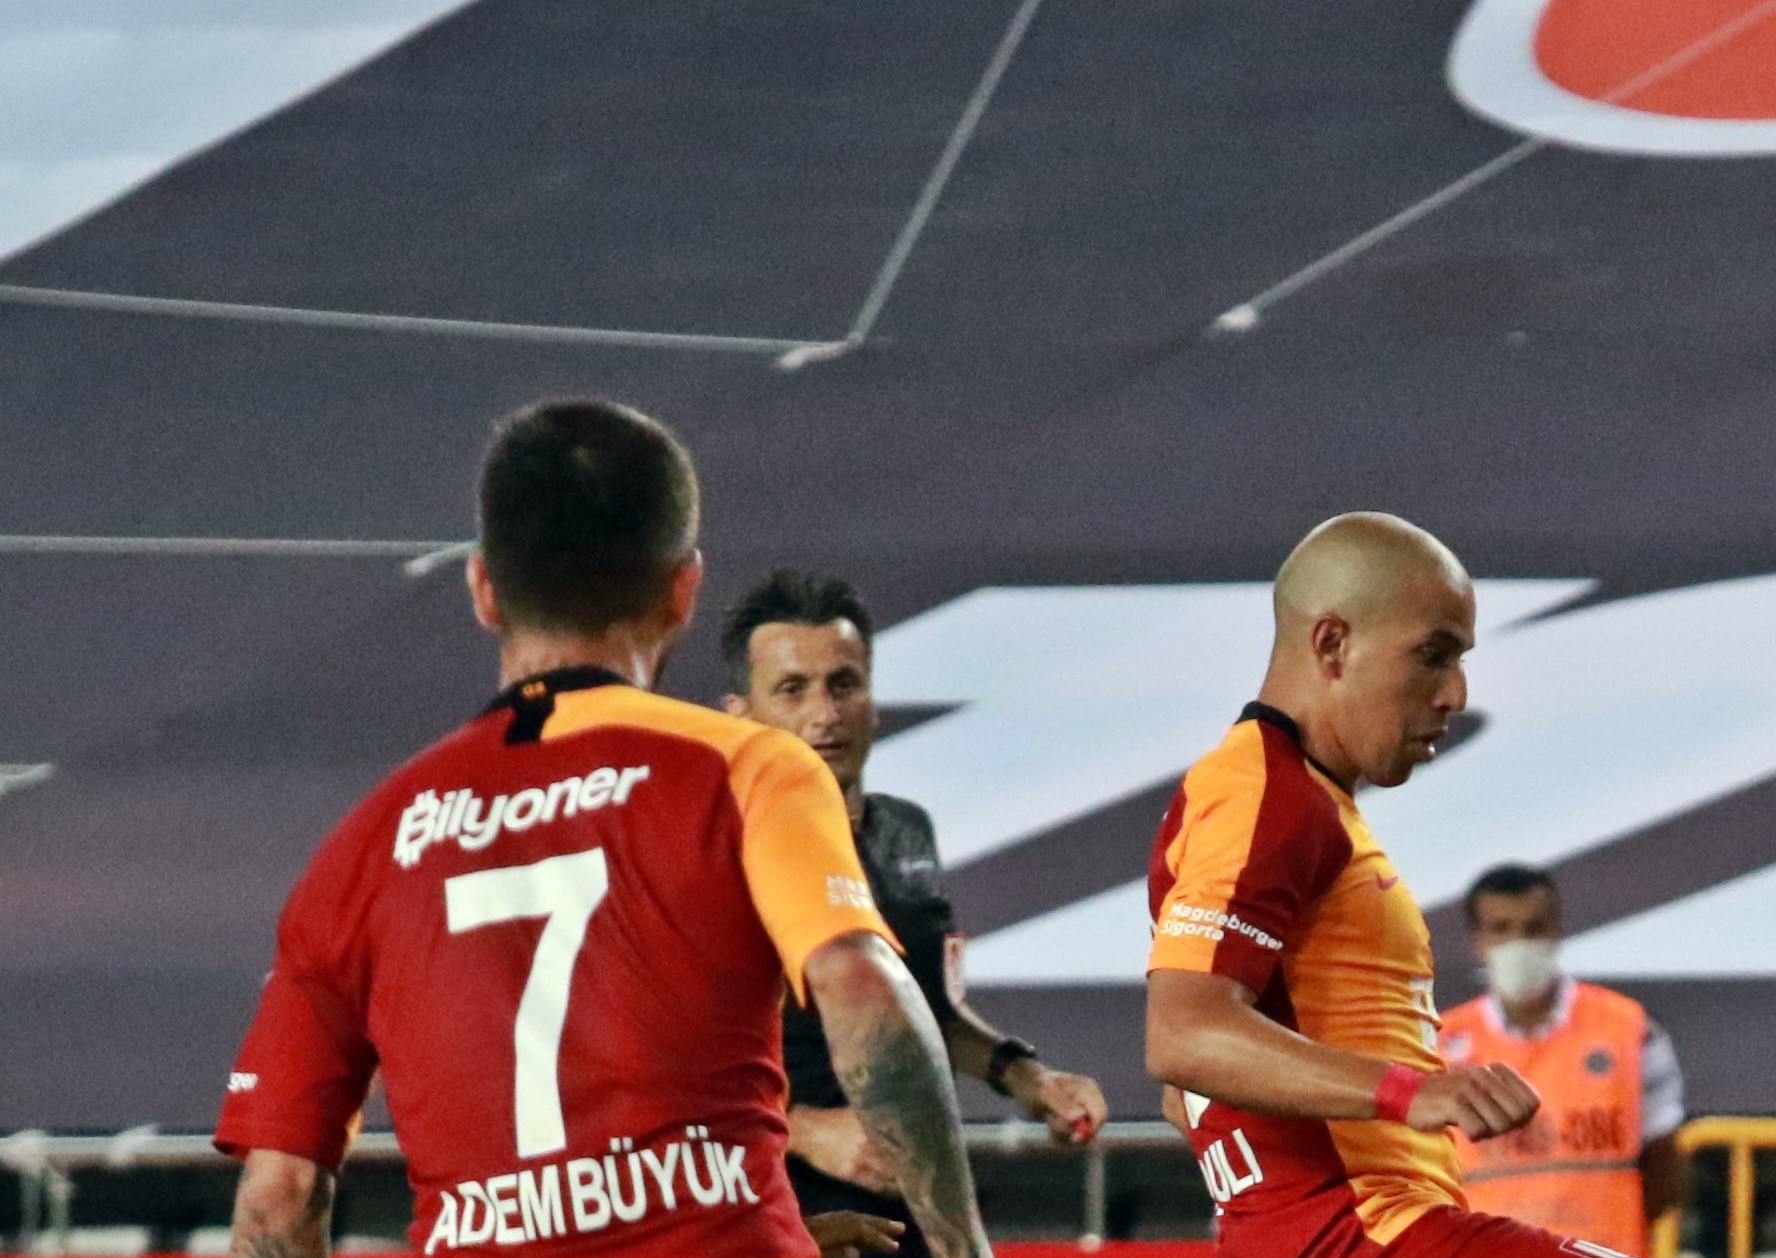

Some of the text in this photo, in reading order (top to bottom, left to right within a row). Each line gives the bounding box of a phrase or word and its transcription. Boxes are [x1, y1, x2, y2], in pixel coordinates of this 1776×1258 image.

[393, 765, 650, 869] Bilyoner
[1168, 902, 1284, 951] Magdeburger
[445, 847, 609, 1159] 7
[424, 1124, 761, 1256] ADEM BÜYÜK
